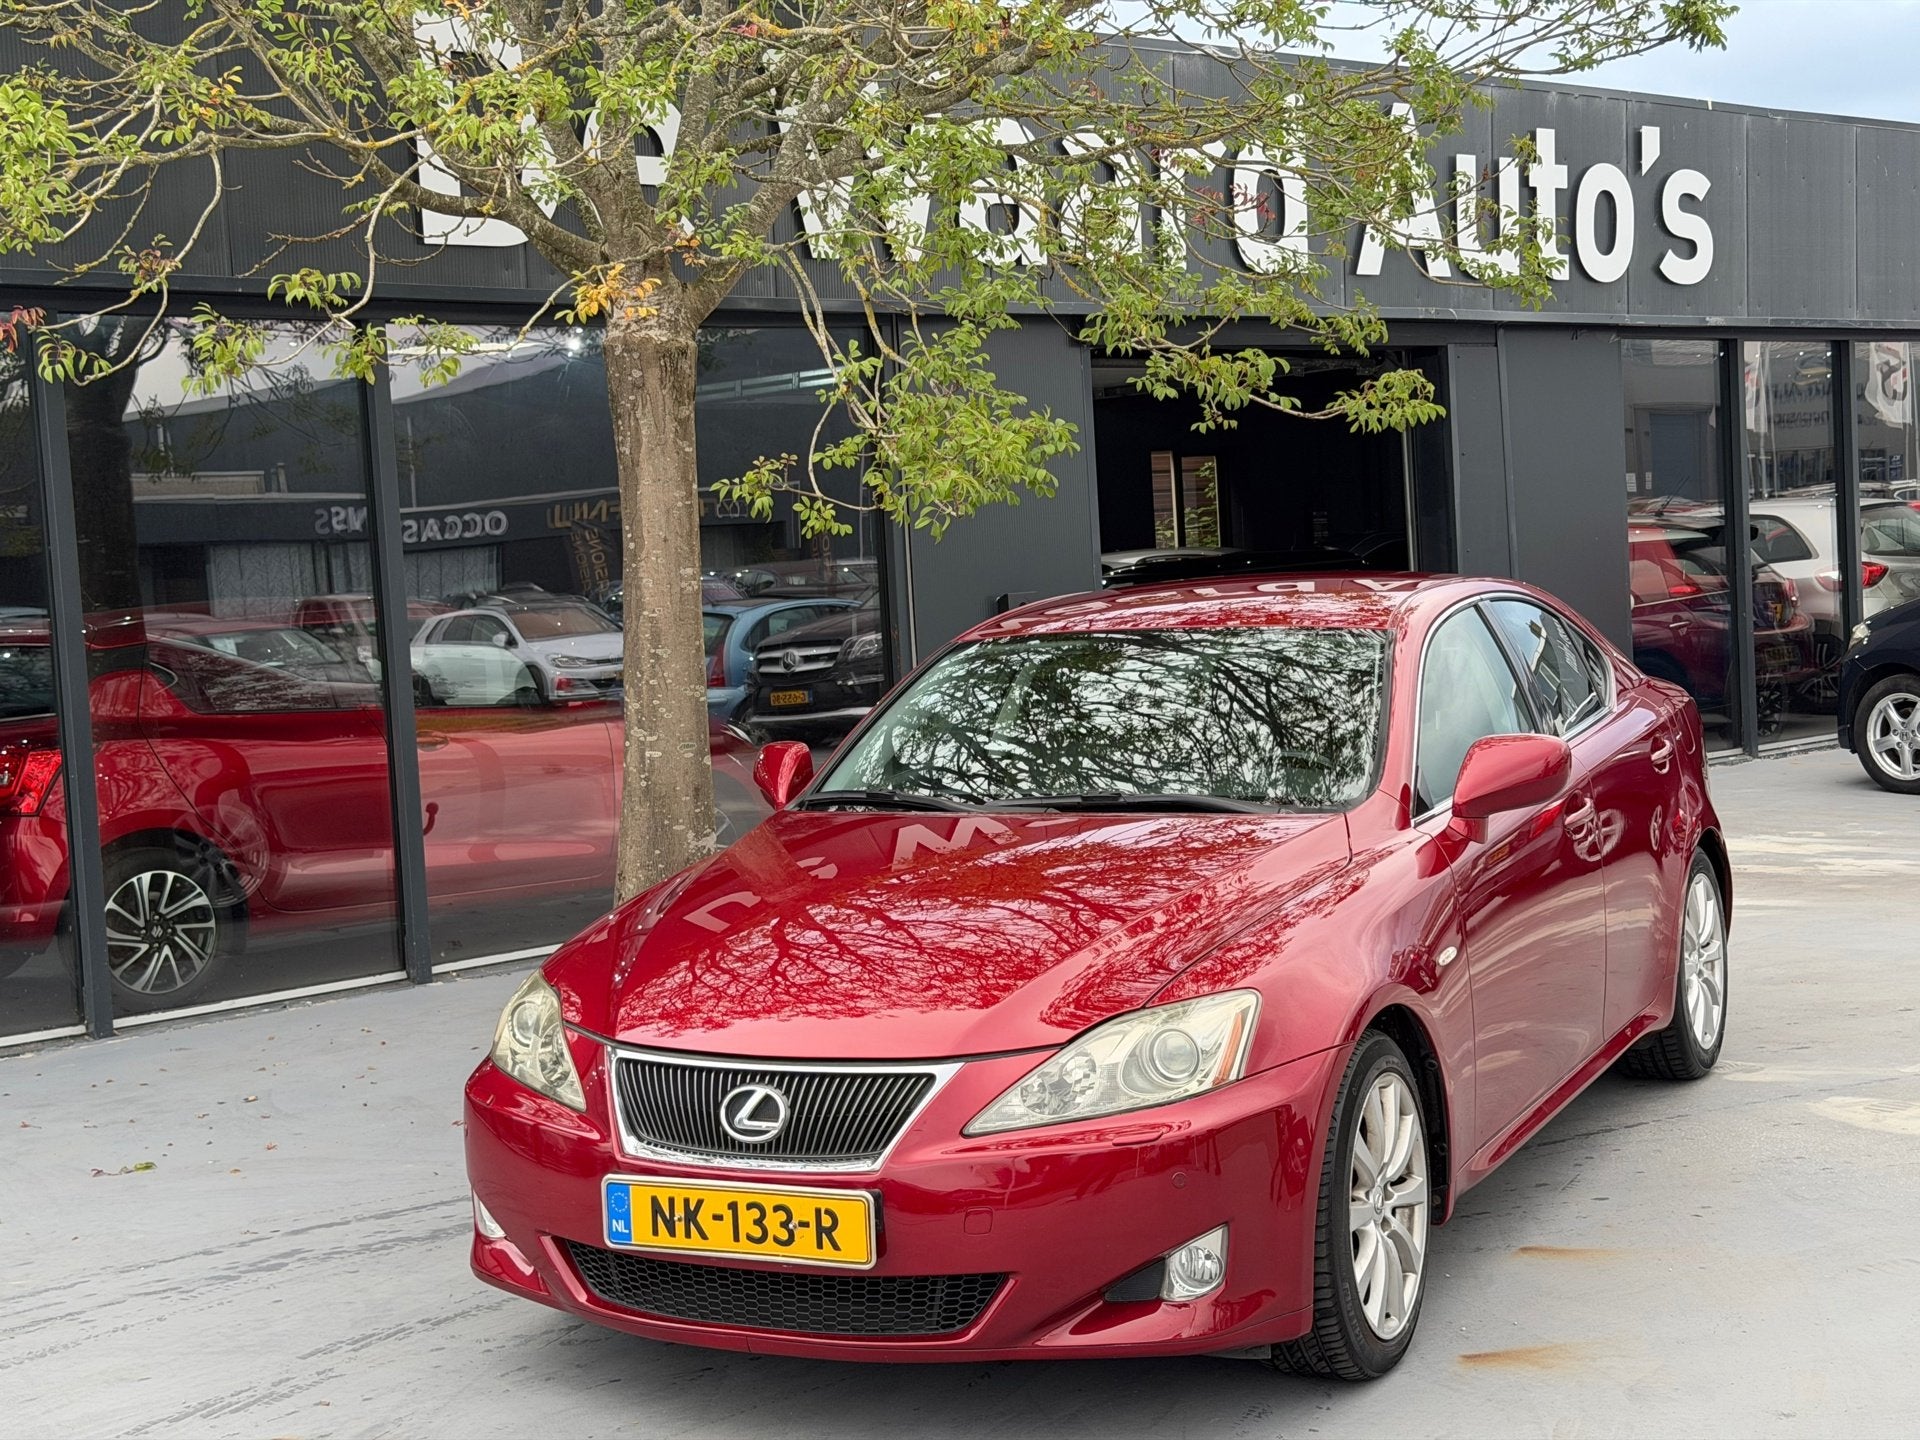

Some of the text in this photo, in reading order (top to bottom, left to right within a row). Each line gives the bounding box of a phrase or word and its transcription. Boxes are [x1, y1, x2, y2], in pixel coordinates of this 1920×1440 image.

[1357, 102, 1714, 285] Auto's
[612, 1195, 842, 1252] NL NK-133-R
